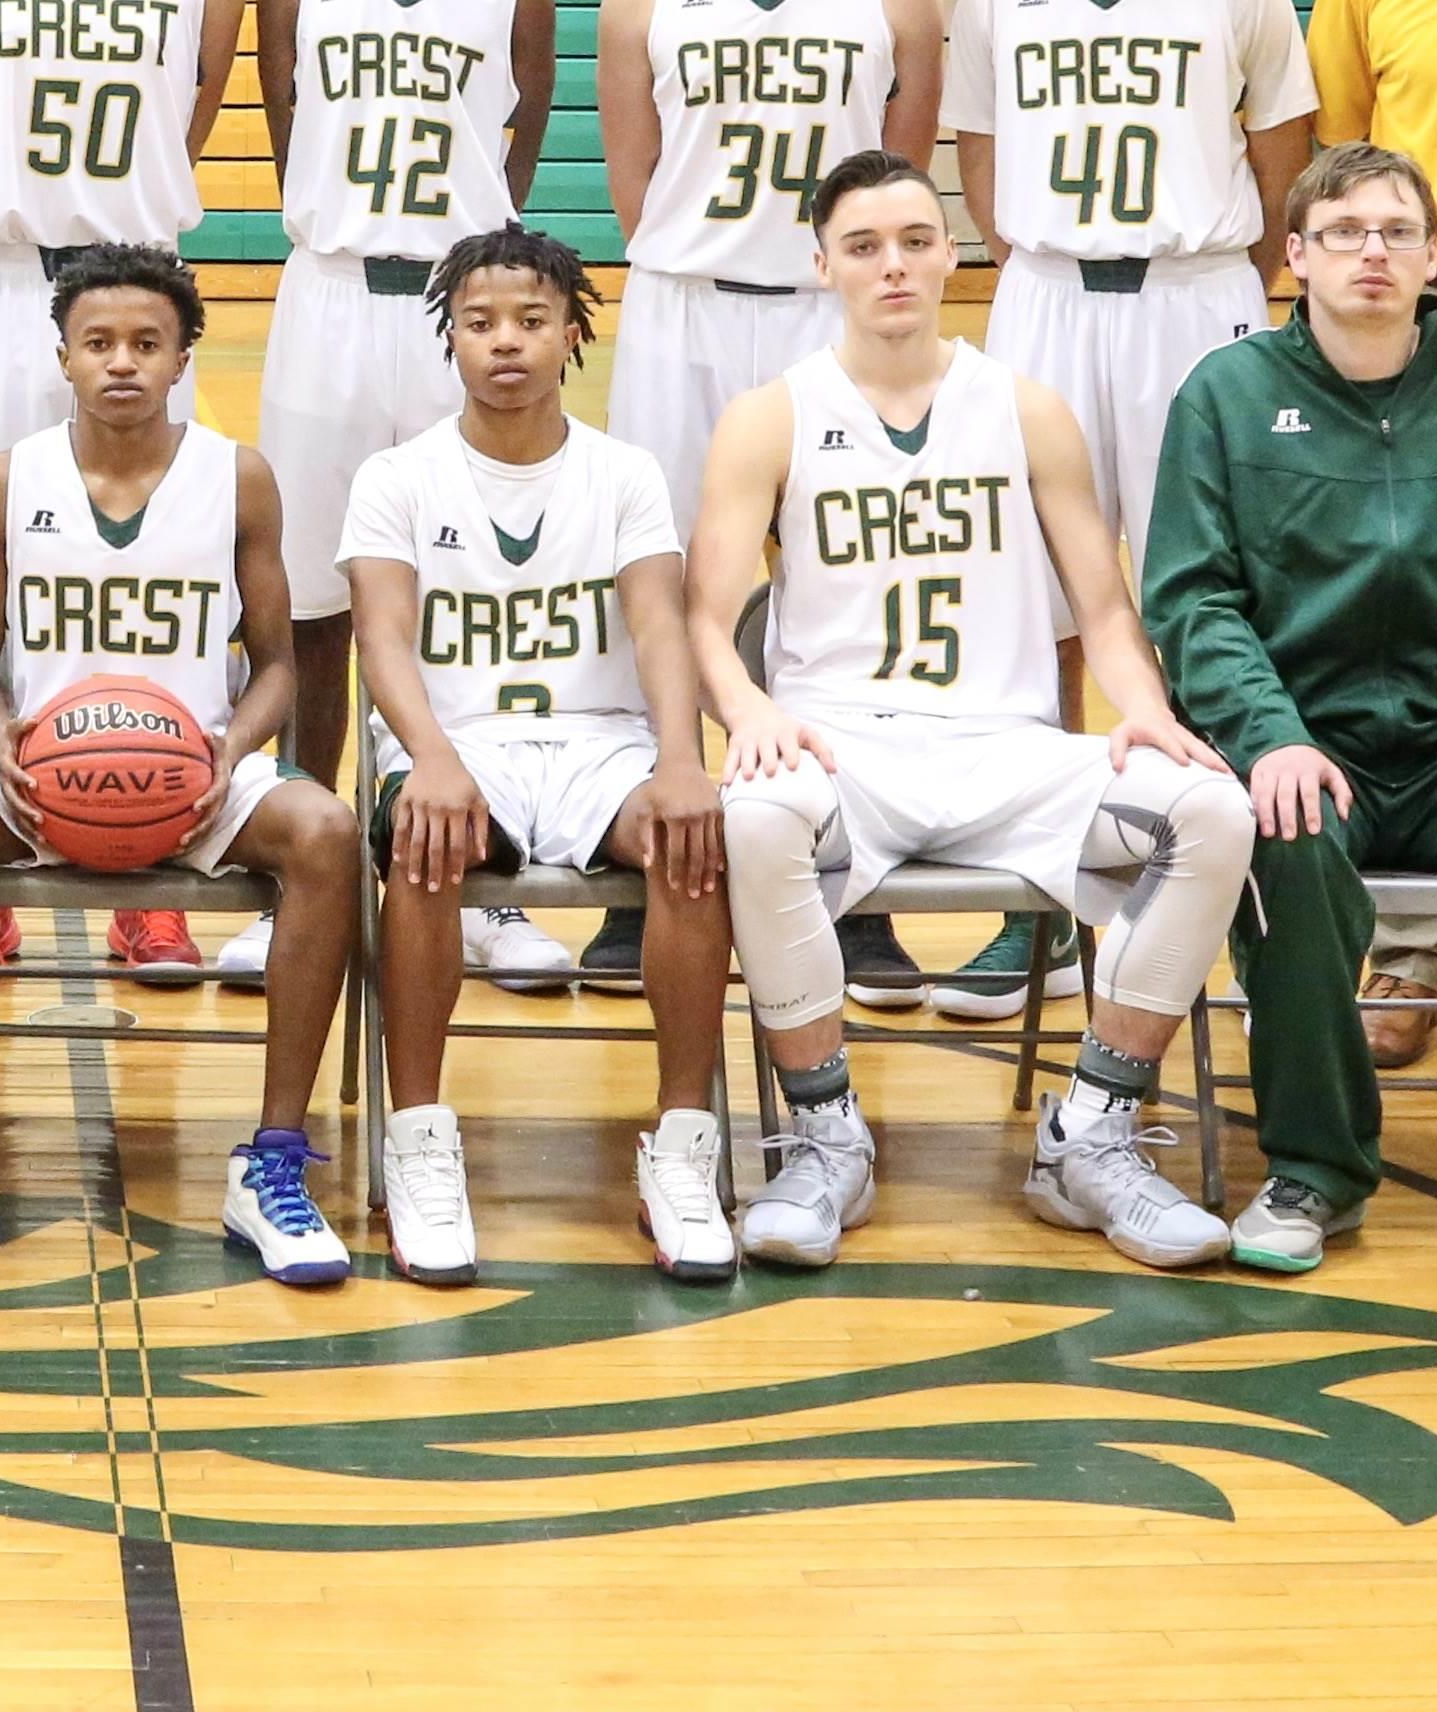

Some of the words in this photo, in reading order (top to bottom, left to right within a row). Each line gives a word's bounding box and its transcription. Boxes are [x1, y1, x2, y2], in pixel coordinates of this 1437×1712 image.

[317, 32, 484, 102] CREST
[677, 35, 864, 108] CREST
[1014, 35, 1202, 110] CREST
[28, 79, 141, 179] 50
[345, 117, 452, 217] 42
[704, 121, 827, 224] 34
[1049, 124, 1158, 226] 40
[813, 474, 1011, 567] CREST
[19, 575, 220, 659] CREST
[419, 576, 616, 668] CREST
[872, 575, 963, 688] 15
[51, 700, 185, 742] Wilson
[54, 766, 187, 794] WAVE
